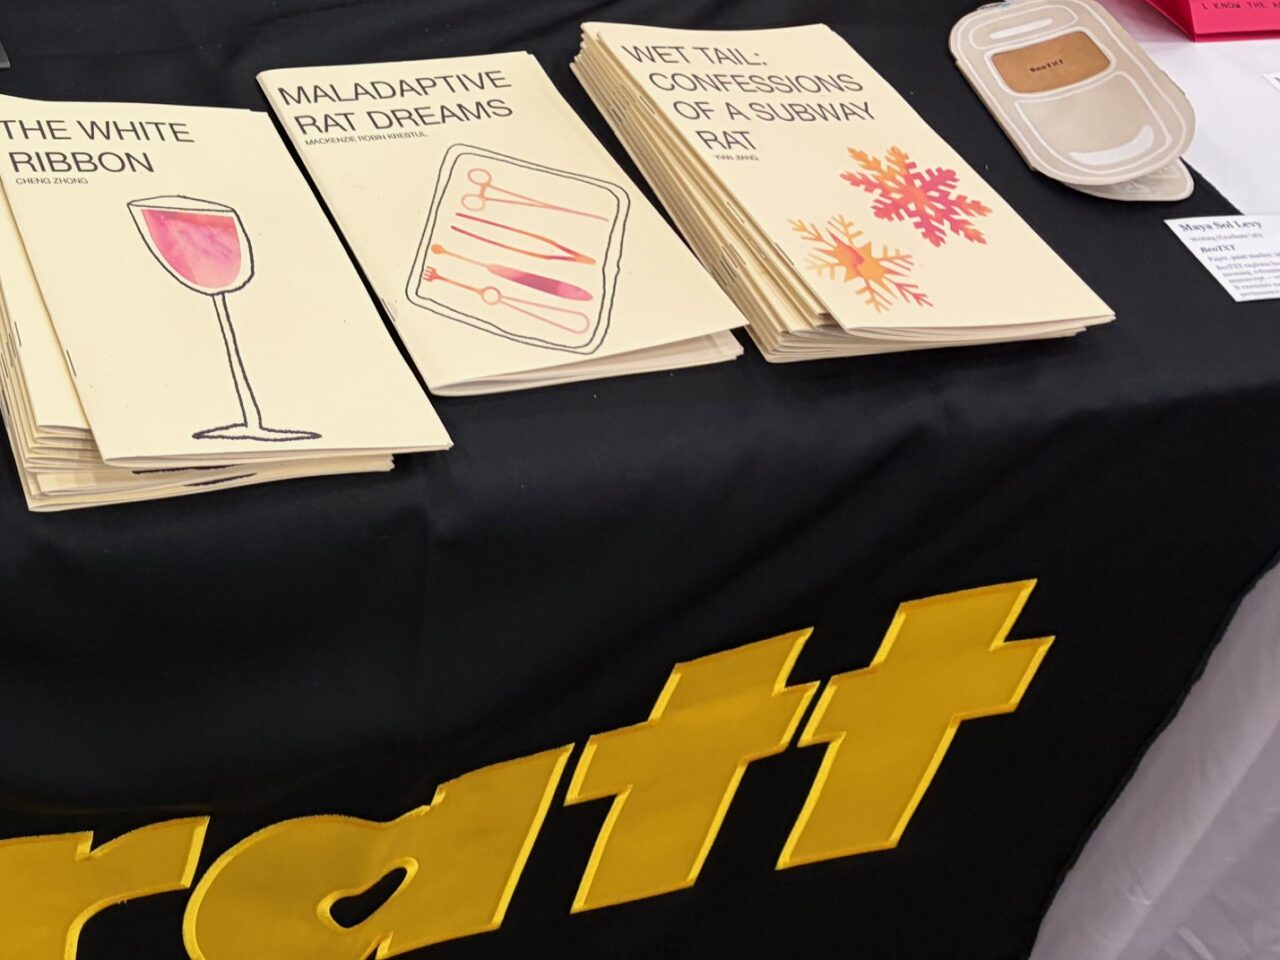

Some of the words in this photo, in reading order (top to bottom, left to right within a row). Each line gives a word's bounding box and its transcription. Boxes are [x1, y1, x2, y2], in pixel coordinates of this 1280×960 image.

[1213, 1, 1241, 9] KNOW
[1246, 1, 1268, 9] THE
[621, 45, 691, 64] WET
[692, 46, 768, 66] TAIL:
[277, 70, 513, 106] MALADAPTIVE
[649, 73, 863, 93] CONFESSIONS
[294, 112, 361, 135] RAT
[366, 99, 513, 130] DREAMS
[673, 100, 715, 120] OF
[725, 101, 751, 121] A
[749, 101, 875, 122] SUBWAY
[76, 120, 195, 143] WHITE
[305, 135, 357, 146] MACKENZIE
[358, 133, 386, 142] ROBIN
[387, 131, 428, 141] KRESTUL
[696, 130, 757, 150] RAT
[8, 151, 155, 173] RIBBON
[15, 177, 51, 185] CHENG
[53, 177, 89, 185] ZHONG
[1178, 223, 1213, 232] Maya
[1213, 220, 1234, 229] Sol
[1234, 220, 1262, 229] Levy
